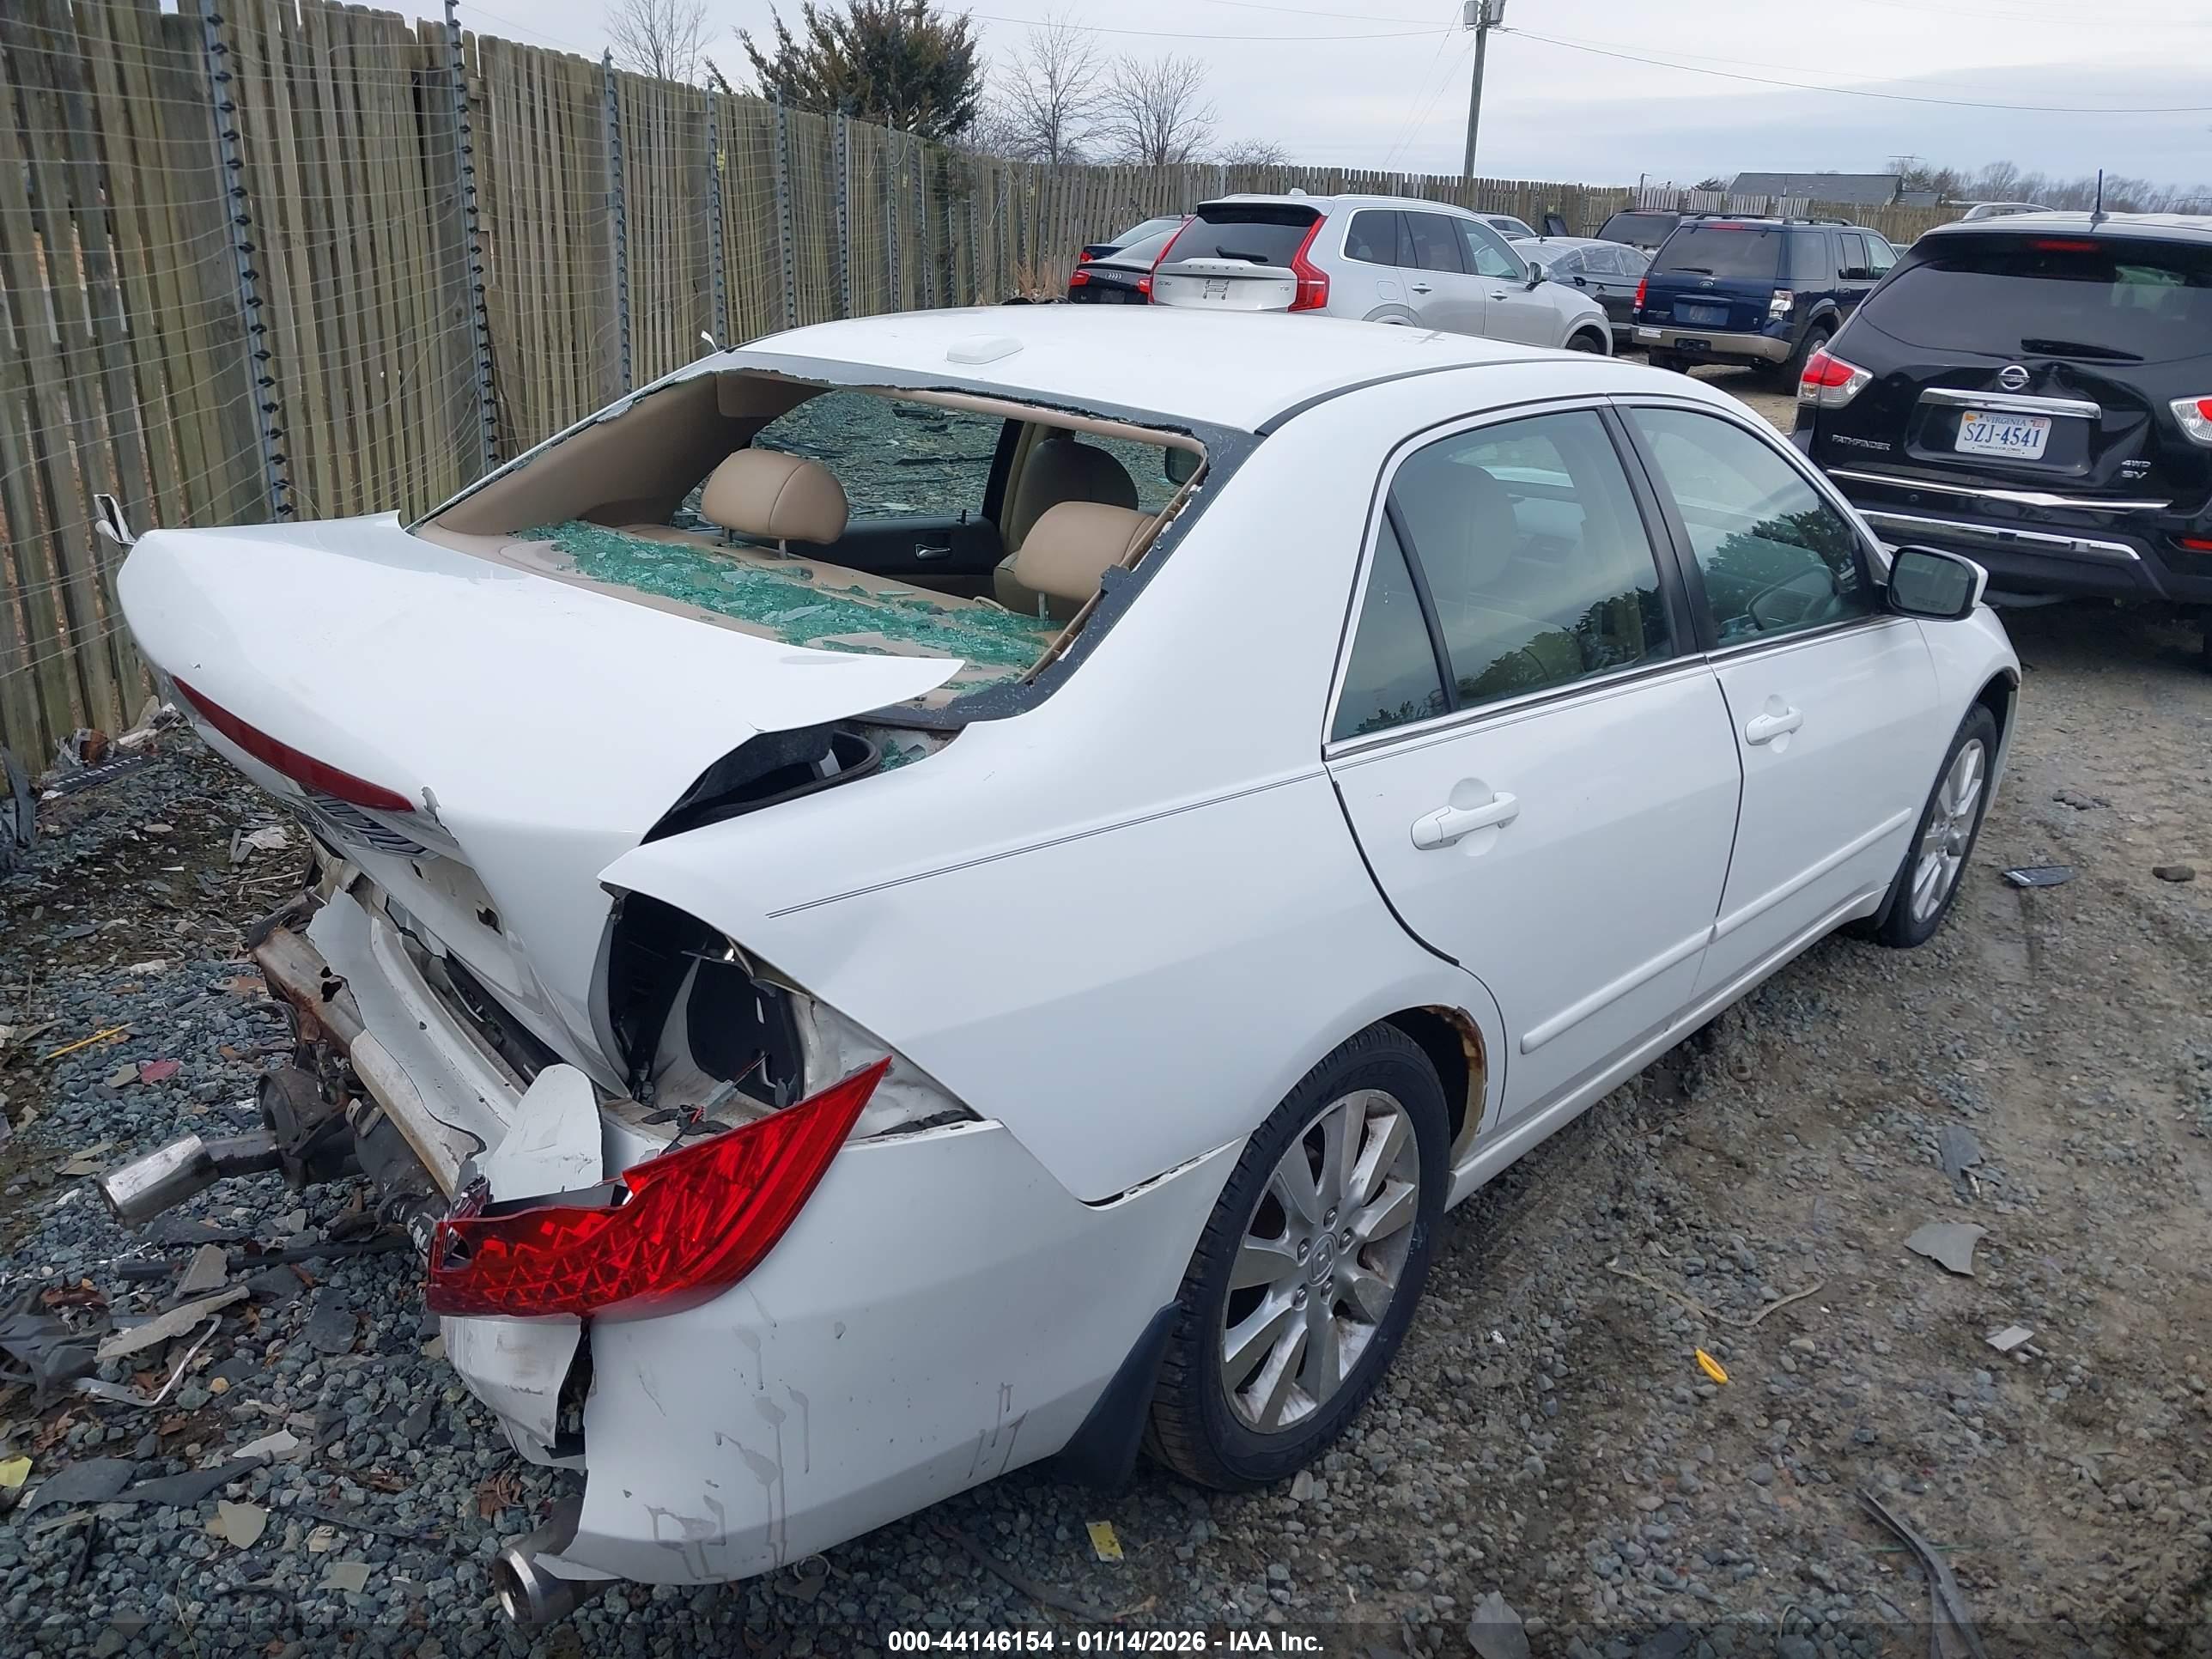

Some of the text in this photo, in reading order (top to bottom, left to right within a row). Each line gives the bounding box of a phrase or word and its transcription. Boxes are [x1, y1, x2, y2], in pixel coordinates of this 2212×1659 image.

[1986, 416, 2027, 427] VIRGINIA
[1832, 434, 1891, 451] PATHFINDER
[1964, 422, 2041, 447] SZJ-4541
[2122, 470, 2148, 479] SV
[52, 755, 143, 787] PRIORITY
